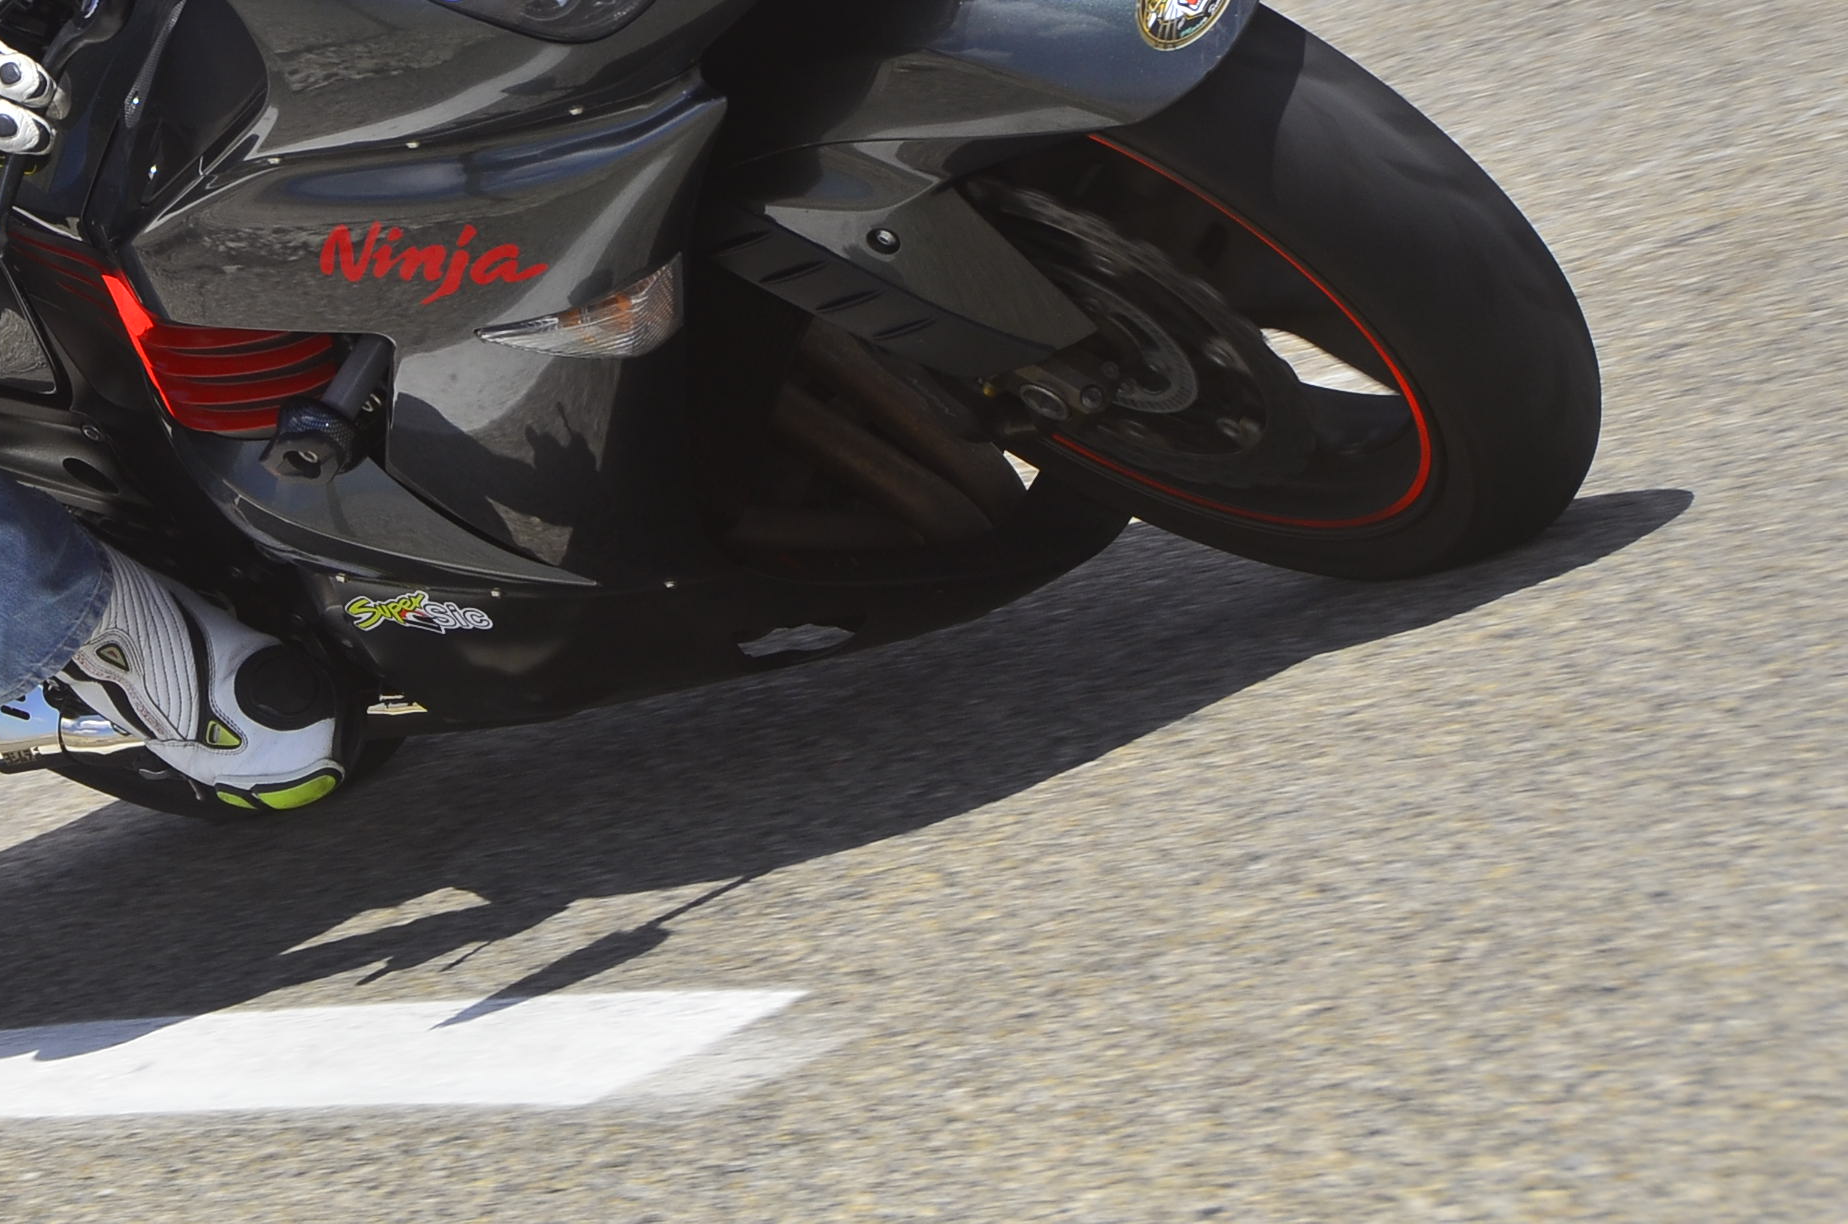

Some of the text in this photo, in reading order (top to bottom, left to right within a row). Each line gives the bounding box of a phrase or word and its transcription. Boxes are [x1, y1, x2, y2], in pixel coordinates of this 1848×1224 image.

[320, 221, 549, 305] Ninja
[347, 591, 493, 630] Super Sic
